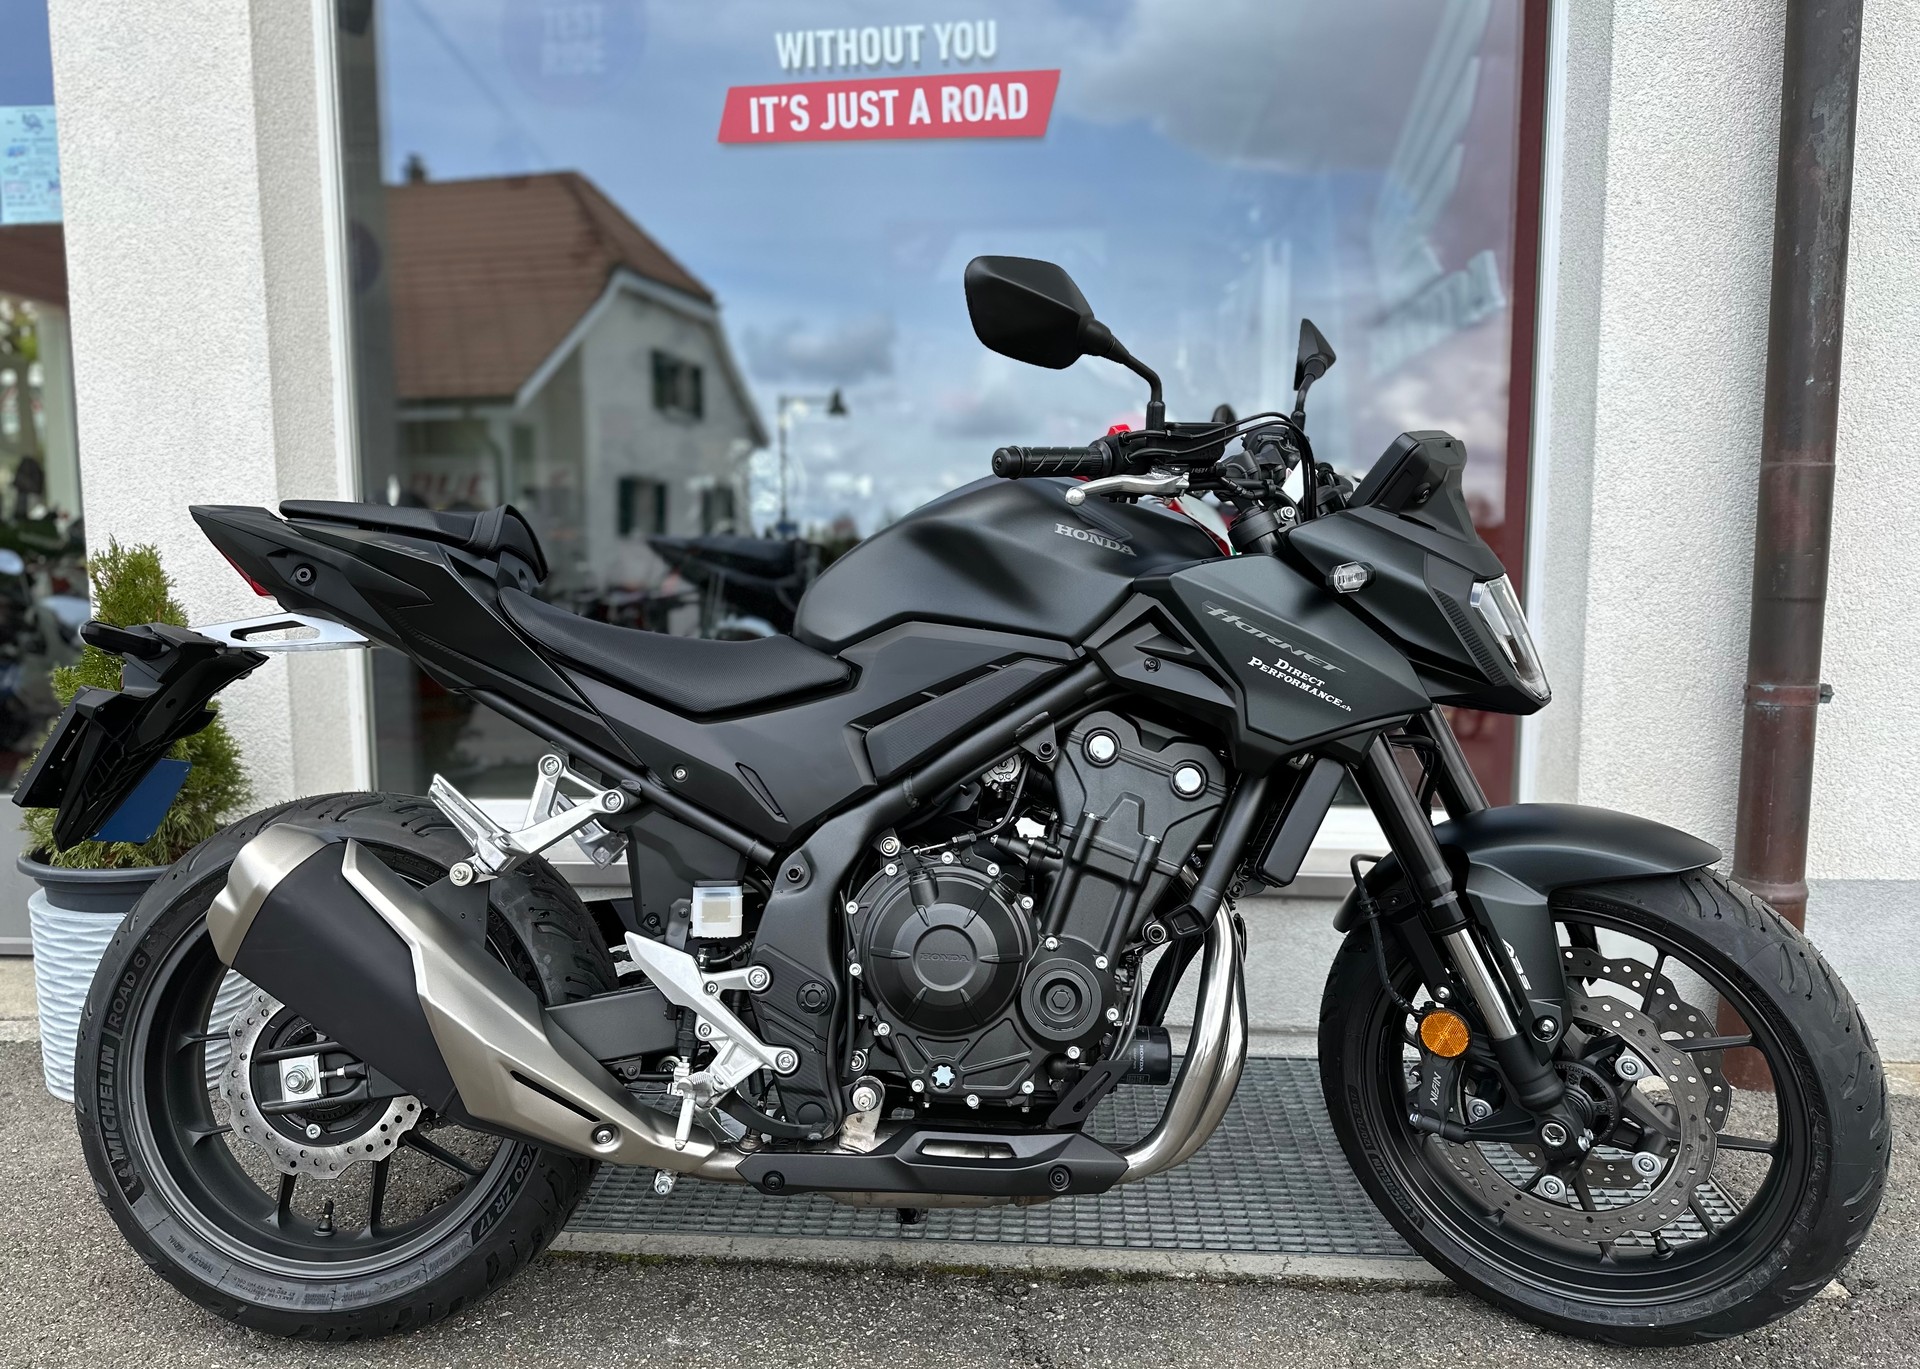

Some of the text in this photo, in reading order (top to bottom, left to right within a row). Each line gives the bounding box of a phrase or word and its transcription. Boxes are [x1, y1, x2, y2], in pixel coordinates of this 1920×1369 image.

[774, 19, 997, 69] WITHOUT YOU
[749, 82, 1029, 134] IT'S JUST A ROAD
[1054, 522, 1137, 557] HONDA
[1203, 602, 1347, 674] HORNET
[1247, 656, 1352, 712] PERFORMANCE.ch
[1274, 658, 1326, 688] DIRECT
[920, 952, 970, 963] HONDA
[1501, 938, 1532, 990] ABS
[100, 953, 147, 1163] MICHELIN ROAD 6
[496, 1184, 514, 1214] ZR
[479, 1212, 494, 1237] 17
